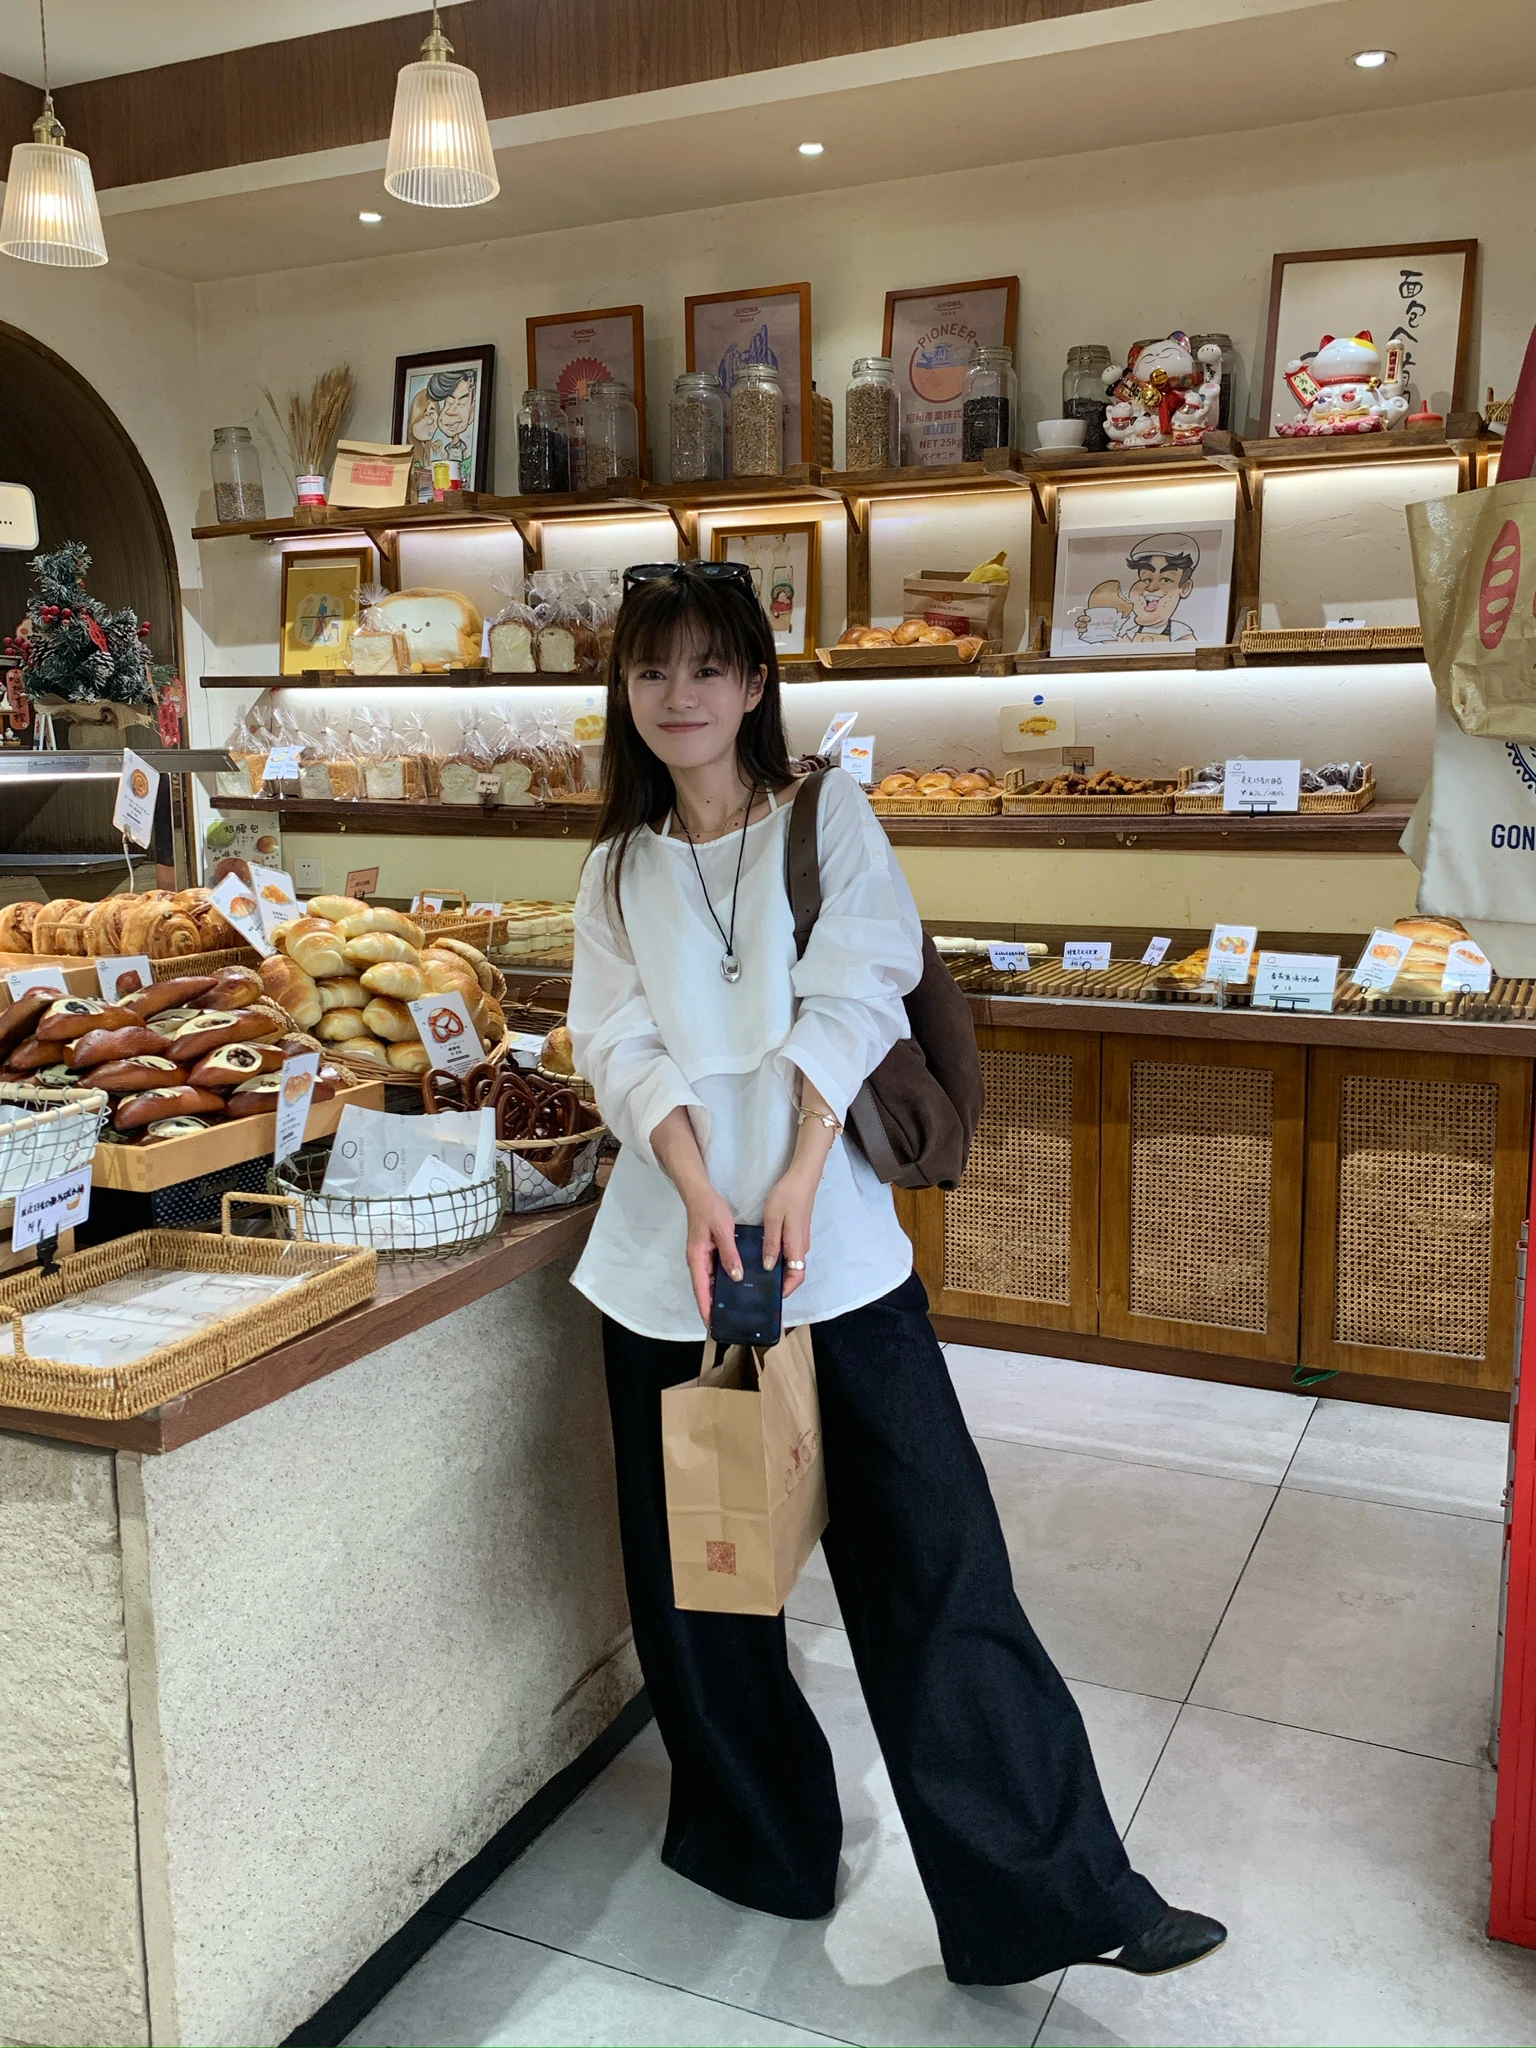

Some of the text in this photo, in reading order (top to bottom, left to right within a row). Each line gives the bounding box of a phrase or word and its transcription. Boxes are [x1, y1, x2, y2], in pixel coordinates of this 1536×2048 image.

[937, 300, 962, 309] SHOWA
[735, 306, 759, 315] SHOWA
[573, 328, 595, 336] SHOWA
[917, 323, 977, 349] PIONEER
[919, 440, 938, 449] NET
[1491, 823, 1536, 851] GON
